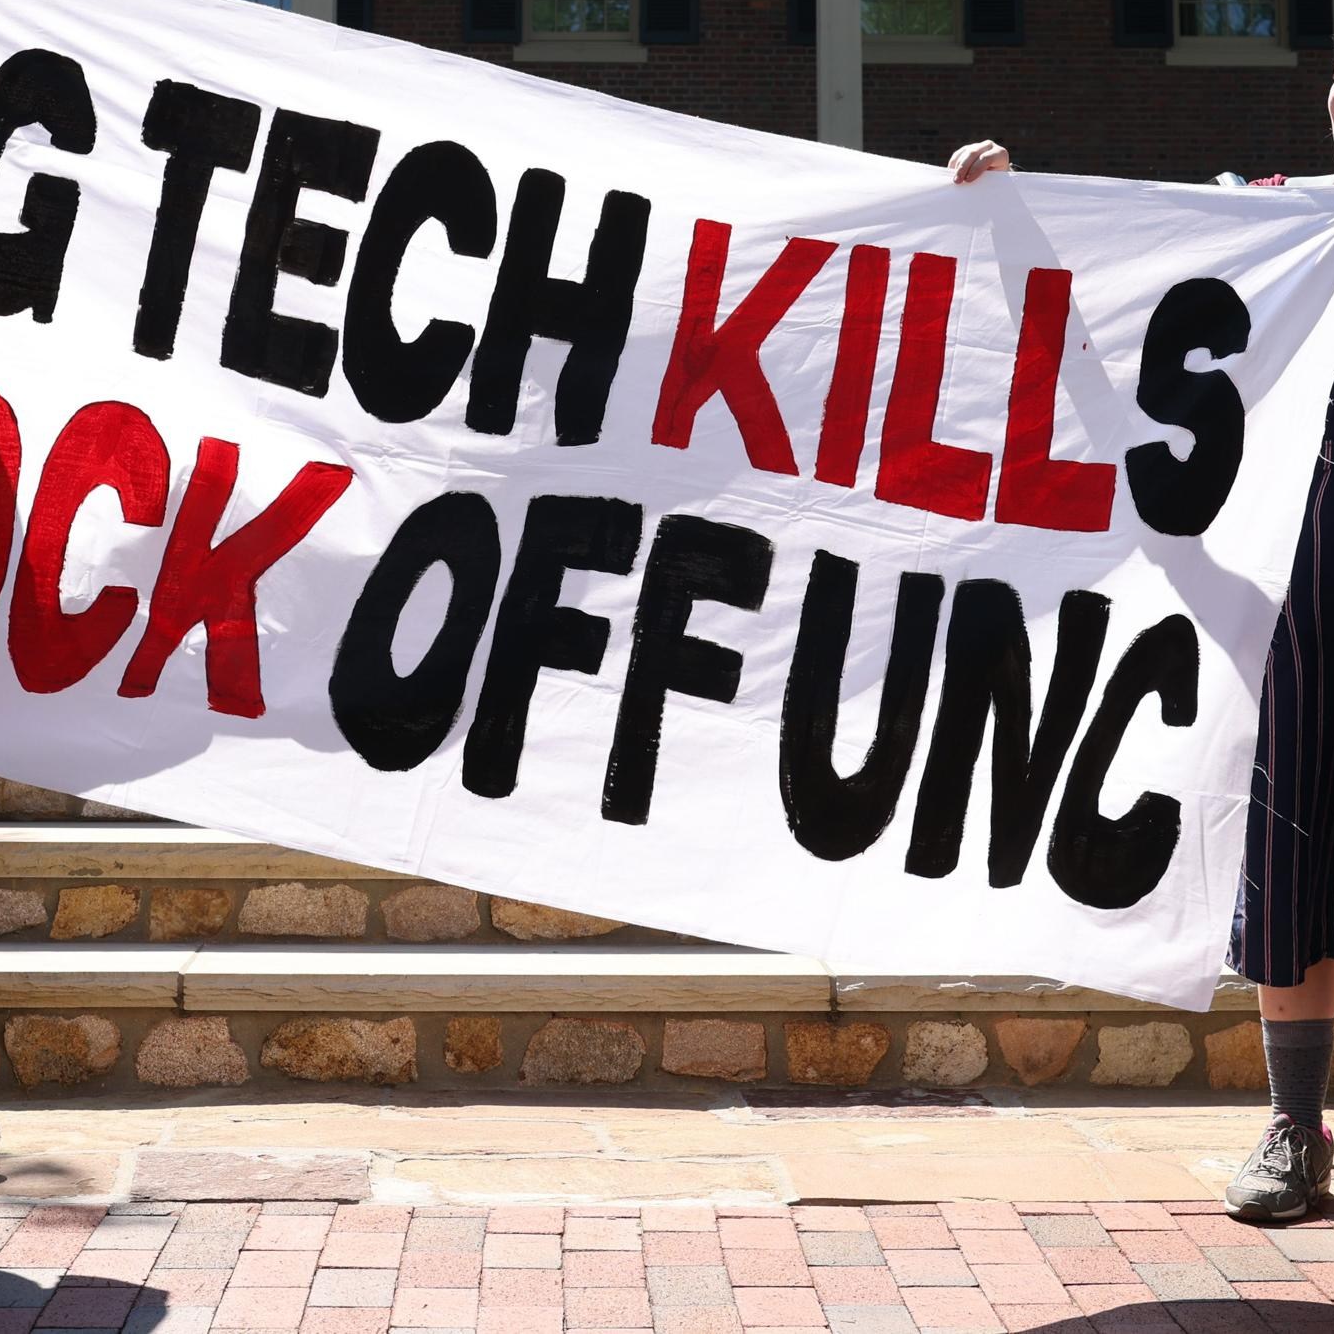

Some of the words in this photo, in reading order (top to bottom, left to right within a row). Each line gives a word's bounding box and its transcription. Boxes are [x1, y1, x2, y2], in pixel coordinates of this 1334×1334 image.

[134, 79, 651, 446] TECH
[653, 219, 1251, 536] KILLS
[329, 492, 773, 825] OFF
[780, 550, 1199, 909] UNC
